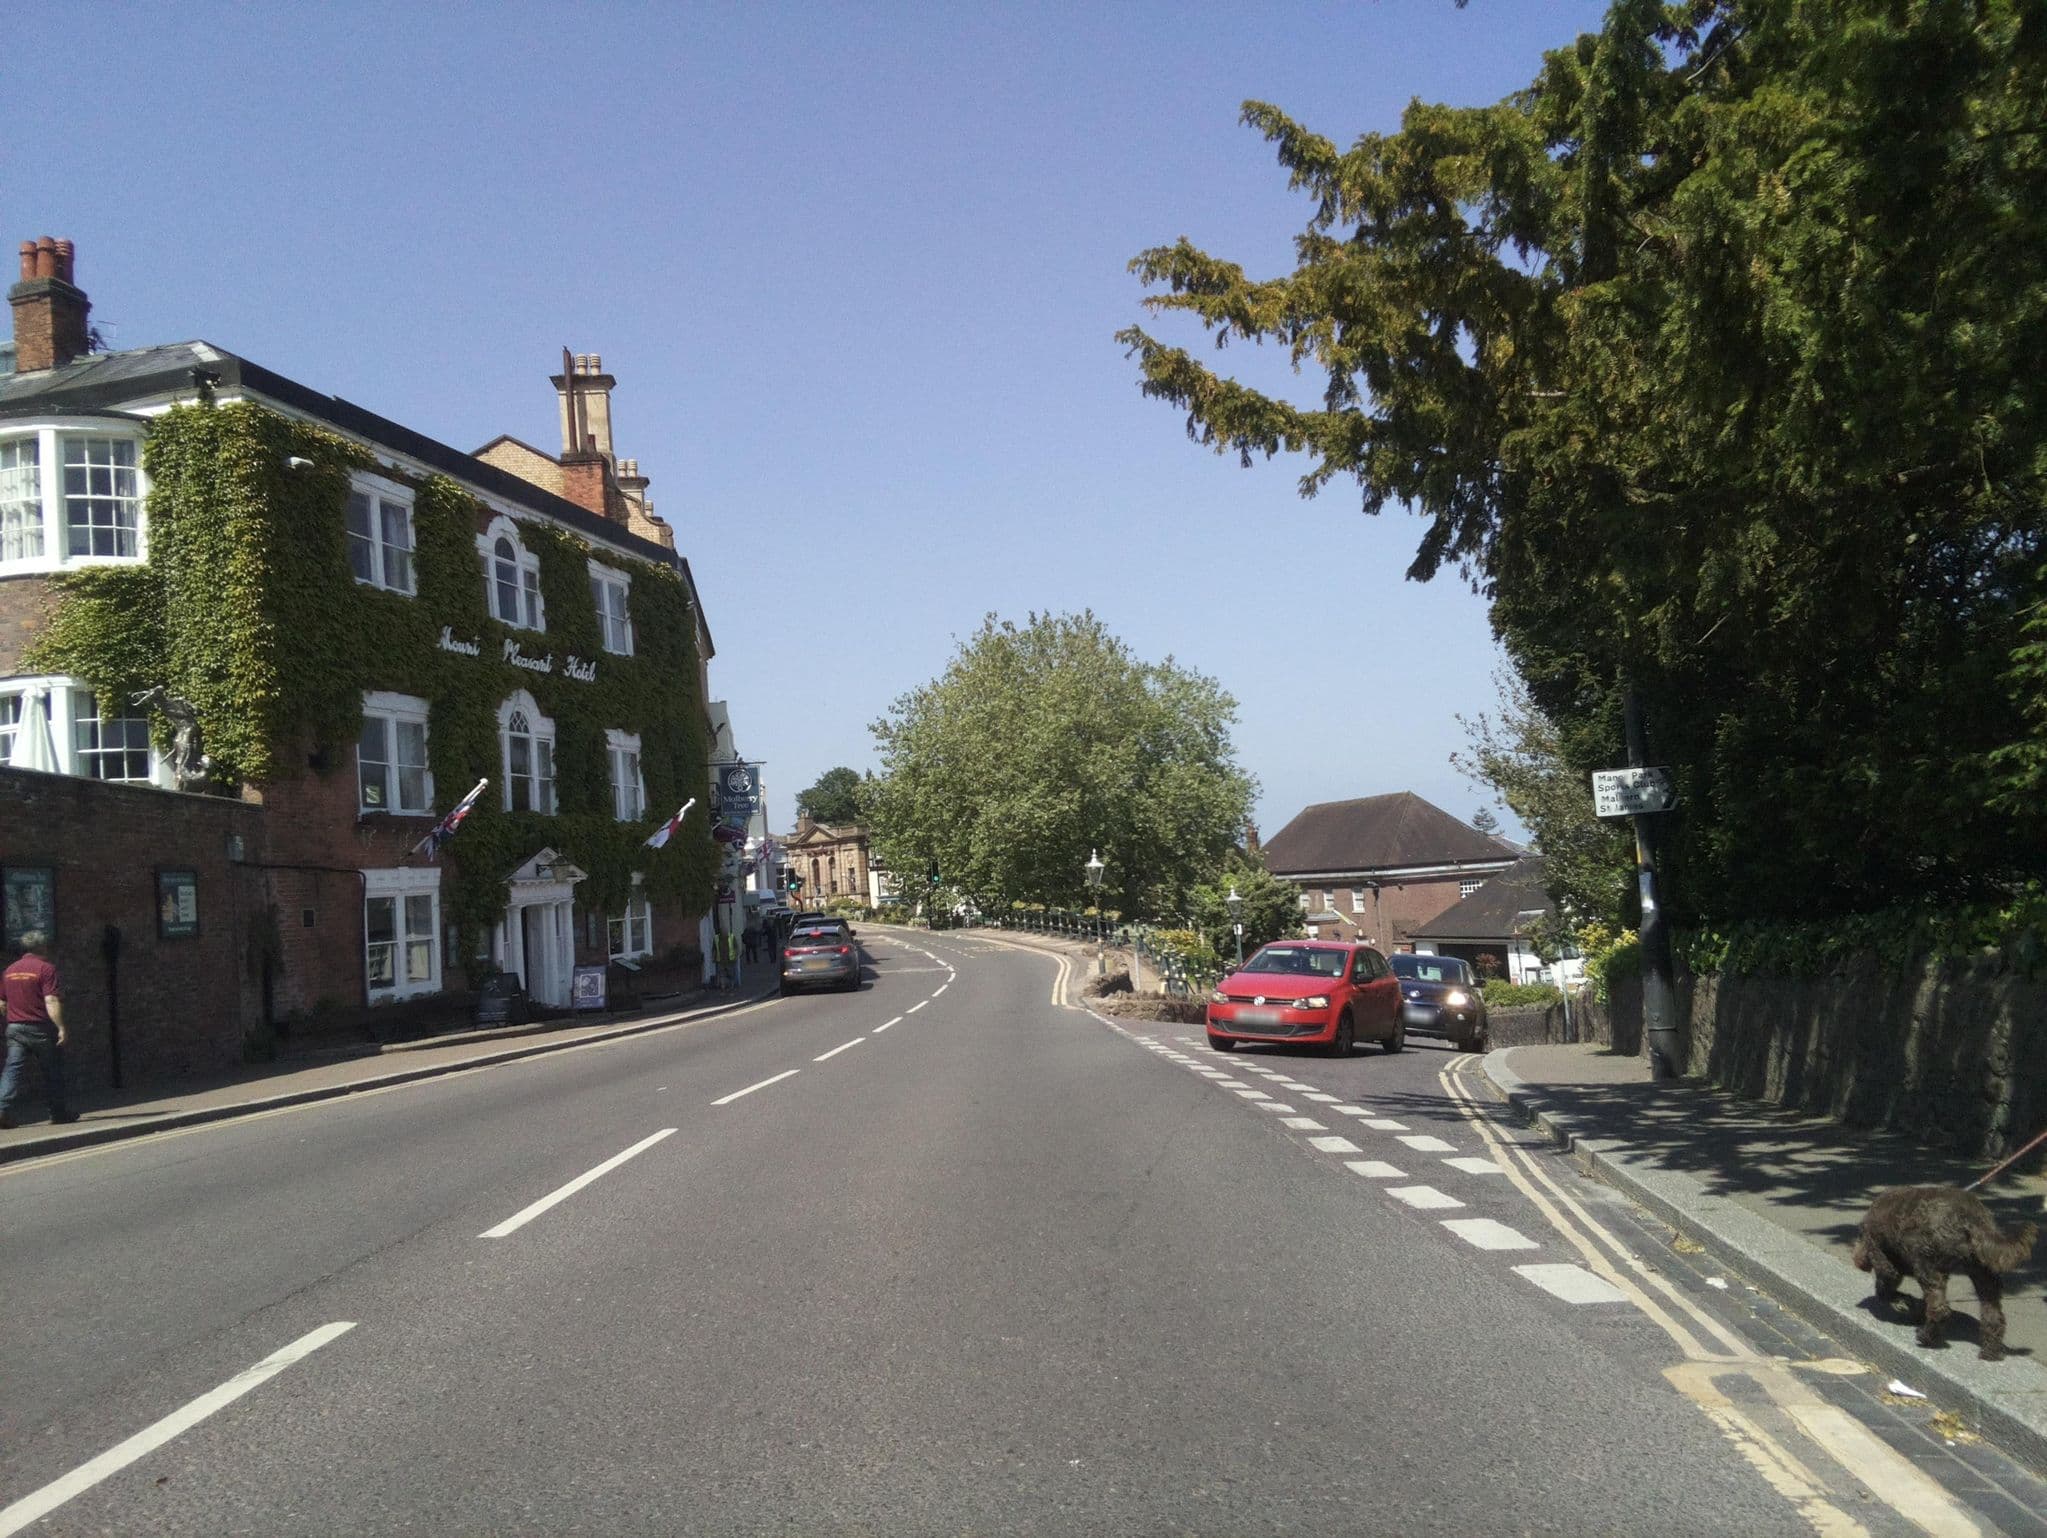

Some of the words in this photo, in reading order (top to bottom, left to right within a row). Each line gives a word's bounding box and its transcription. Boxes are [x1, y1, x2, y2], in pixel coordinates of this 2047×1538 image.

[437, 625, 481, 656] Mount
[502, 638, 553, 673] Pleasant
[563, 655, 597, 682] Hotel
[1598, 774, 1627, 782] Mano
[1601, 793, 1640, 803] Malern
